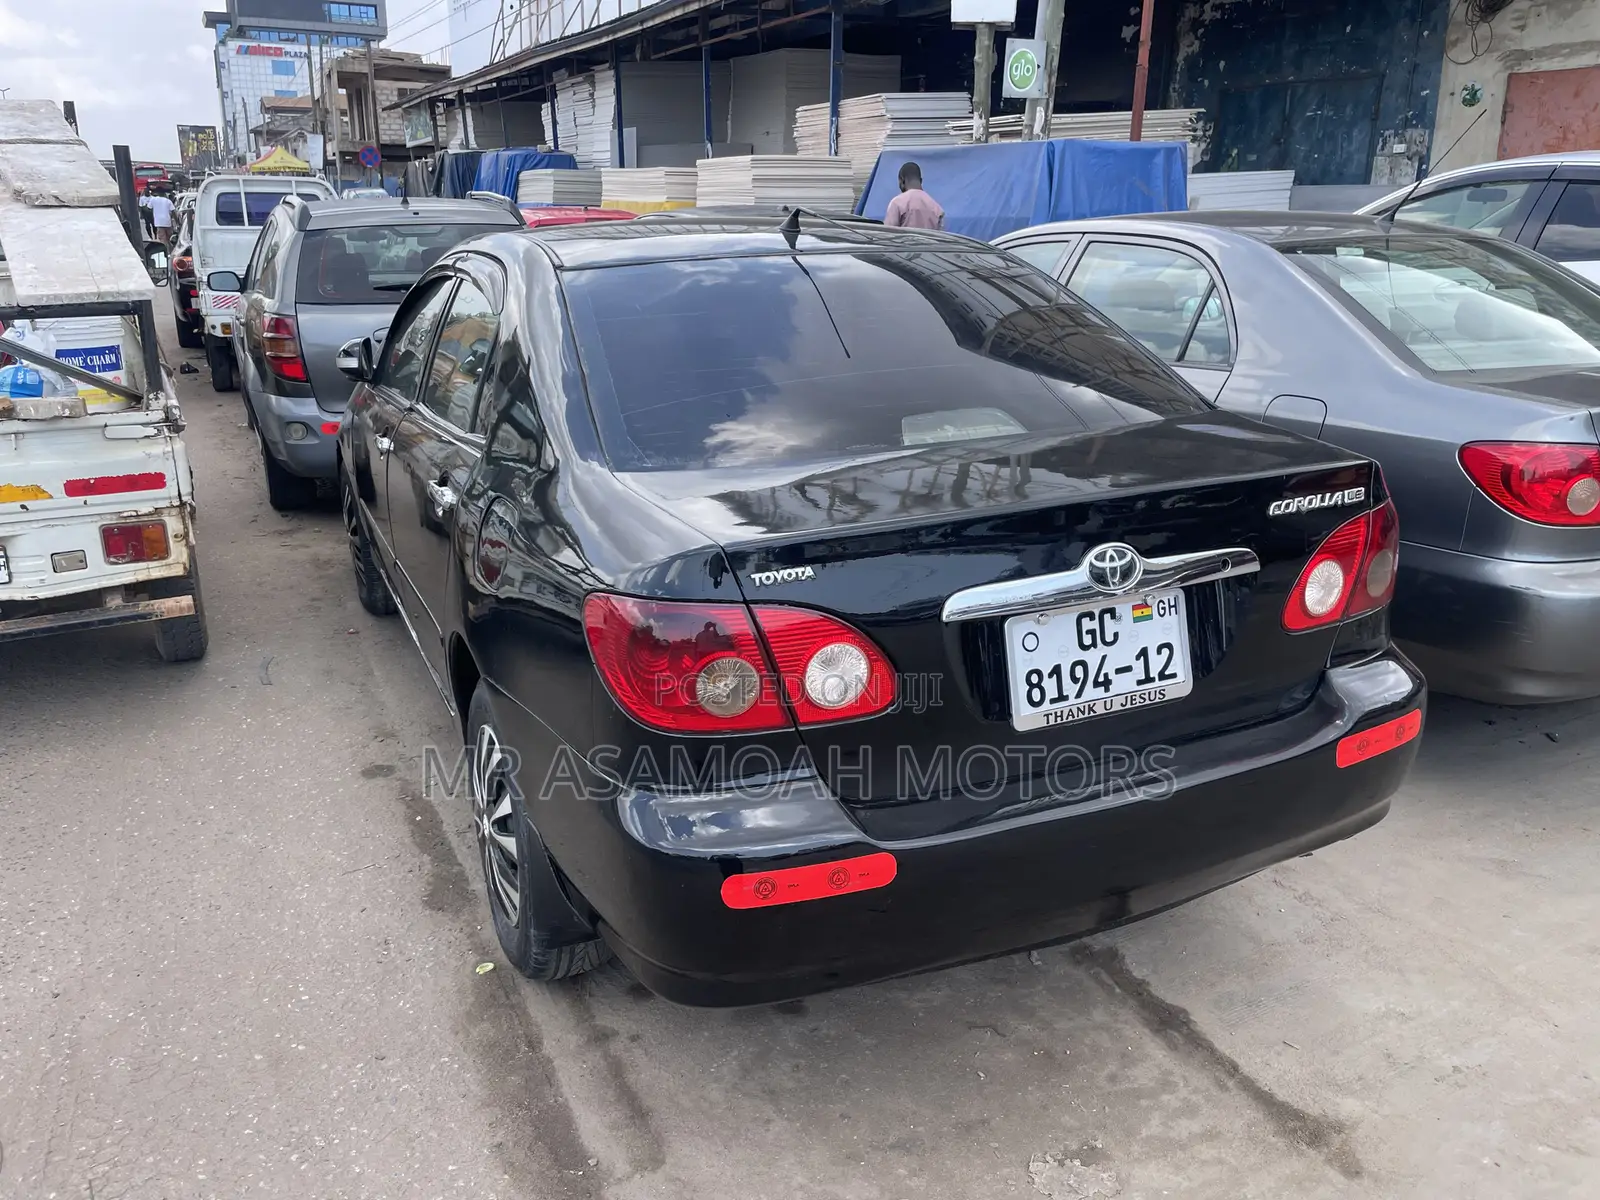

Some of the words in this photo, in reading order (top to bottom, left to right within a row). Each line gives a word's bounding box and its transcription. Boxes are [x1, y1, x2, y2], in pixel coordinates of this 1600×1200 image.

[284, 51, 308, 59] PLAZA
[1012, 59, 1033, 80] glo
[87, 354, 116, 366] CHARM
[1269, 490, 1343, 516] COROLLA
[750, 566, 816, 587] TOYOTA
[1075, 607, 1119, 651] GC
[1157, 597, 1178, 617] GH
[1025, 642, 1178, 708] 8194-12
[1043, 703, 1097, 725] THANK
[1103, 699, 1114, 712] U
[1120, 688, 1166, 708] JESUS
